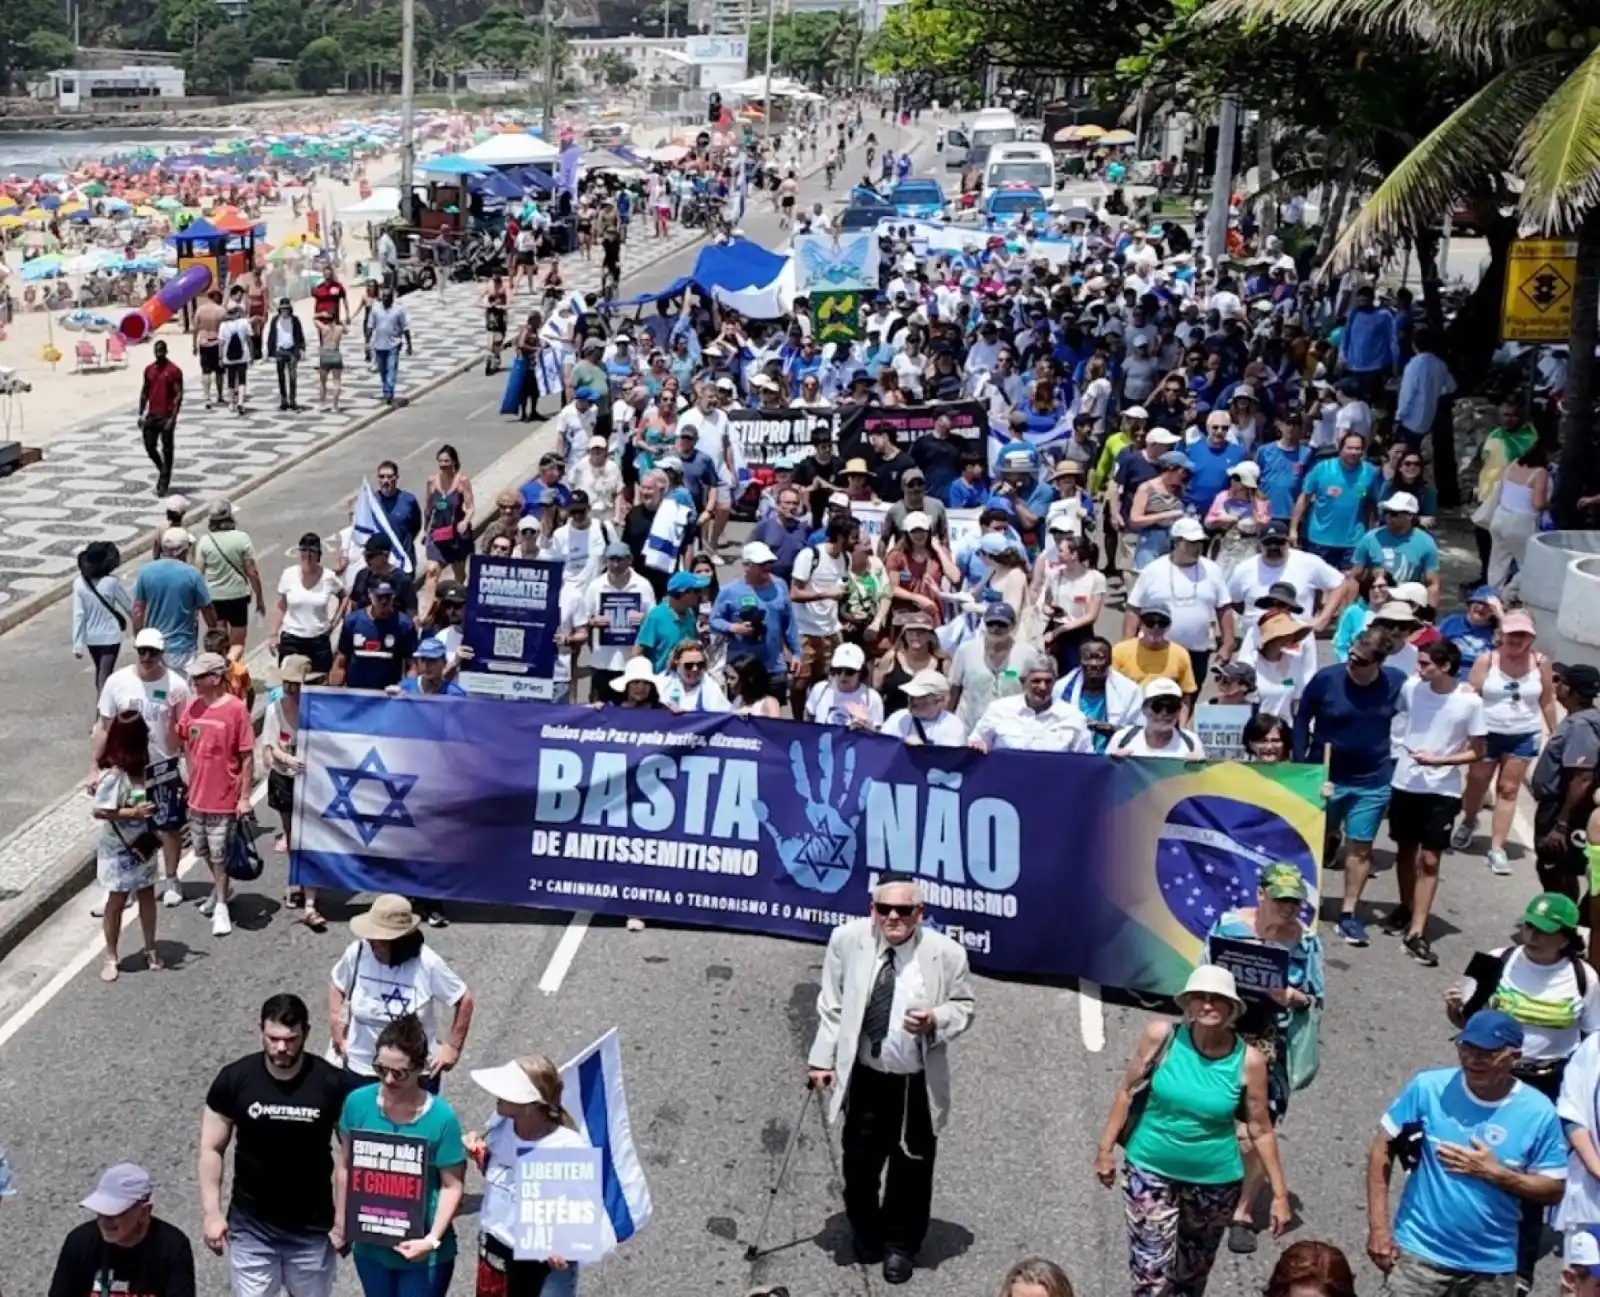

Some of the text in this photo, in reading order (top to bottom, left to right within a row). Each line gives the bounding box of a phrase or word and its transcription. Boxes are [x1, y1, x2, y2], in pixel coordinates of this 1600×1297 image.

[730, 42, 745, 57] 12
[728, 420, 791, 443] STUPRO
[479, 578, 548, 599] COMBATER
[541, 724, 580, 740] Unidos
[579, 728, 607, 744] pela
[607, 728, 629, 743] Paz
[629, 731, 638, 744] e
[635, 730, 664, 747] pela
[535, 748, 760, 841] BASTA
[866, 768, 1020, 890] NÃO
[531, 830, 759, 877] DE ANTISSEMITISMO
[546, 879, 619, 899] CAMINHADA
[622, 886, 671, 904] CONTRA
[674, 891, 683, 905] O
[687, 893, 768, 916] TERRORISMO
[771, 902, 780, 916] E
[782, 905, 791, 919] O
[521, 1161, 595, 1181] LIBERTEM
[364, 1171, 421, 1200] CRIME!
[521, 1181, 541, 1199] OS
[520, 1194, 596, 1224] REFÉNS
